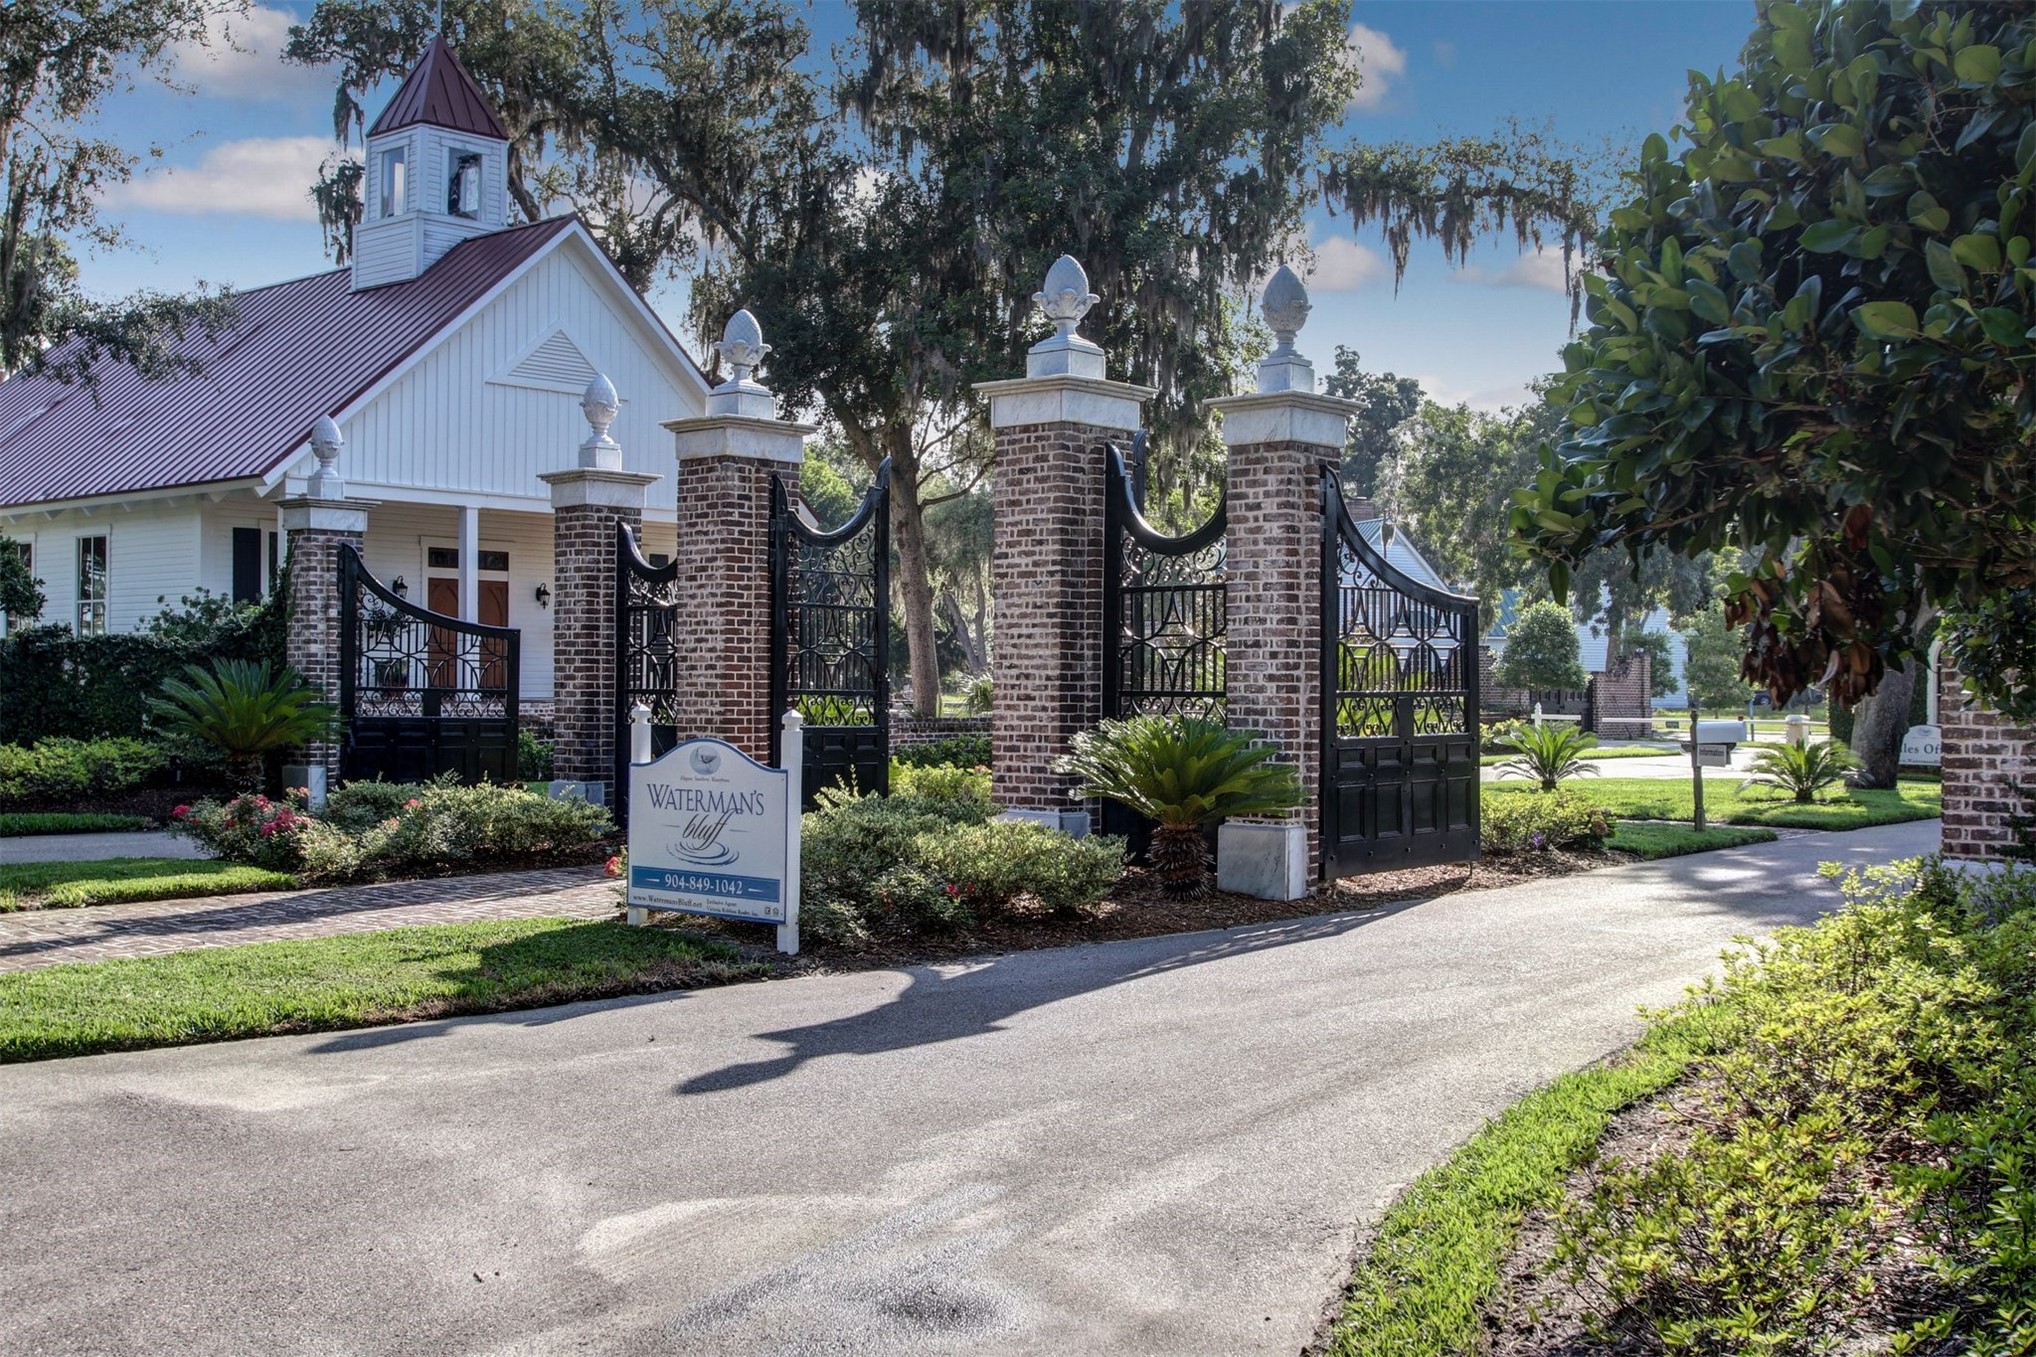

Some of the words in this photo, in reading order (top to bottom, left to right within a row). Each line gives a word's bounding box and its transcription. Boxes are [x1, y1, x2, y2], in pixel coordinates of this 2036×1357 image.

[1900, 743, 1919, 754] les
[682, 808, 744, 851] bluff
[665, 873, 743, 895] 904-849-1042
[633, 894, 702, 908] www.WatermansBluff.net
